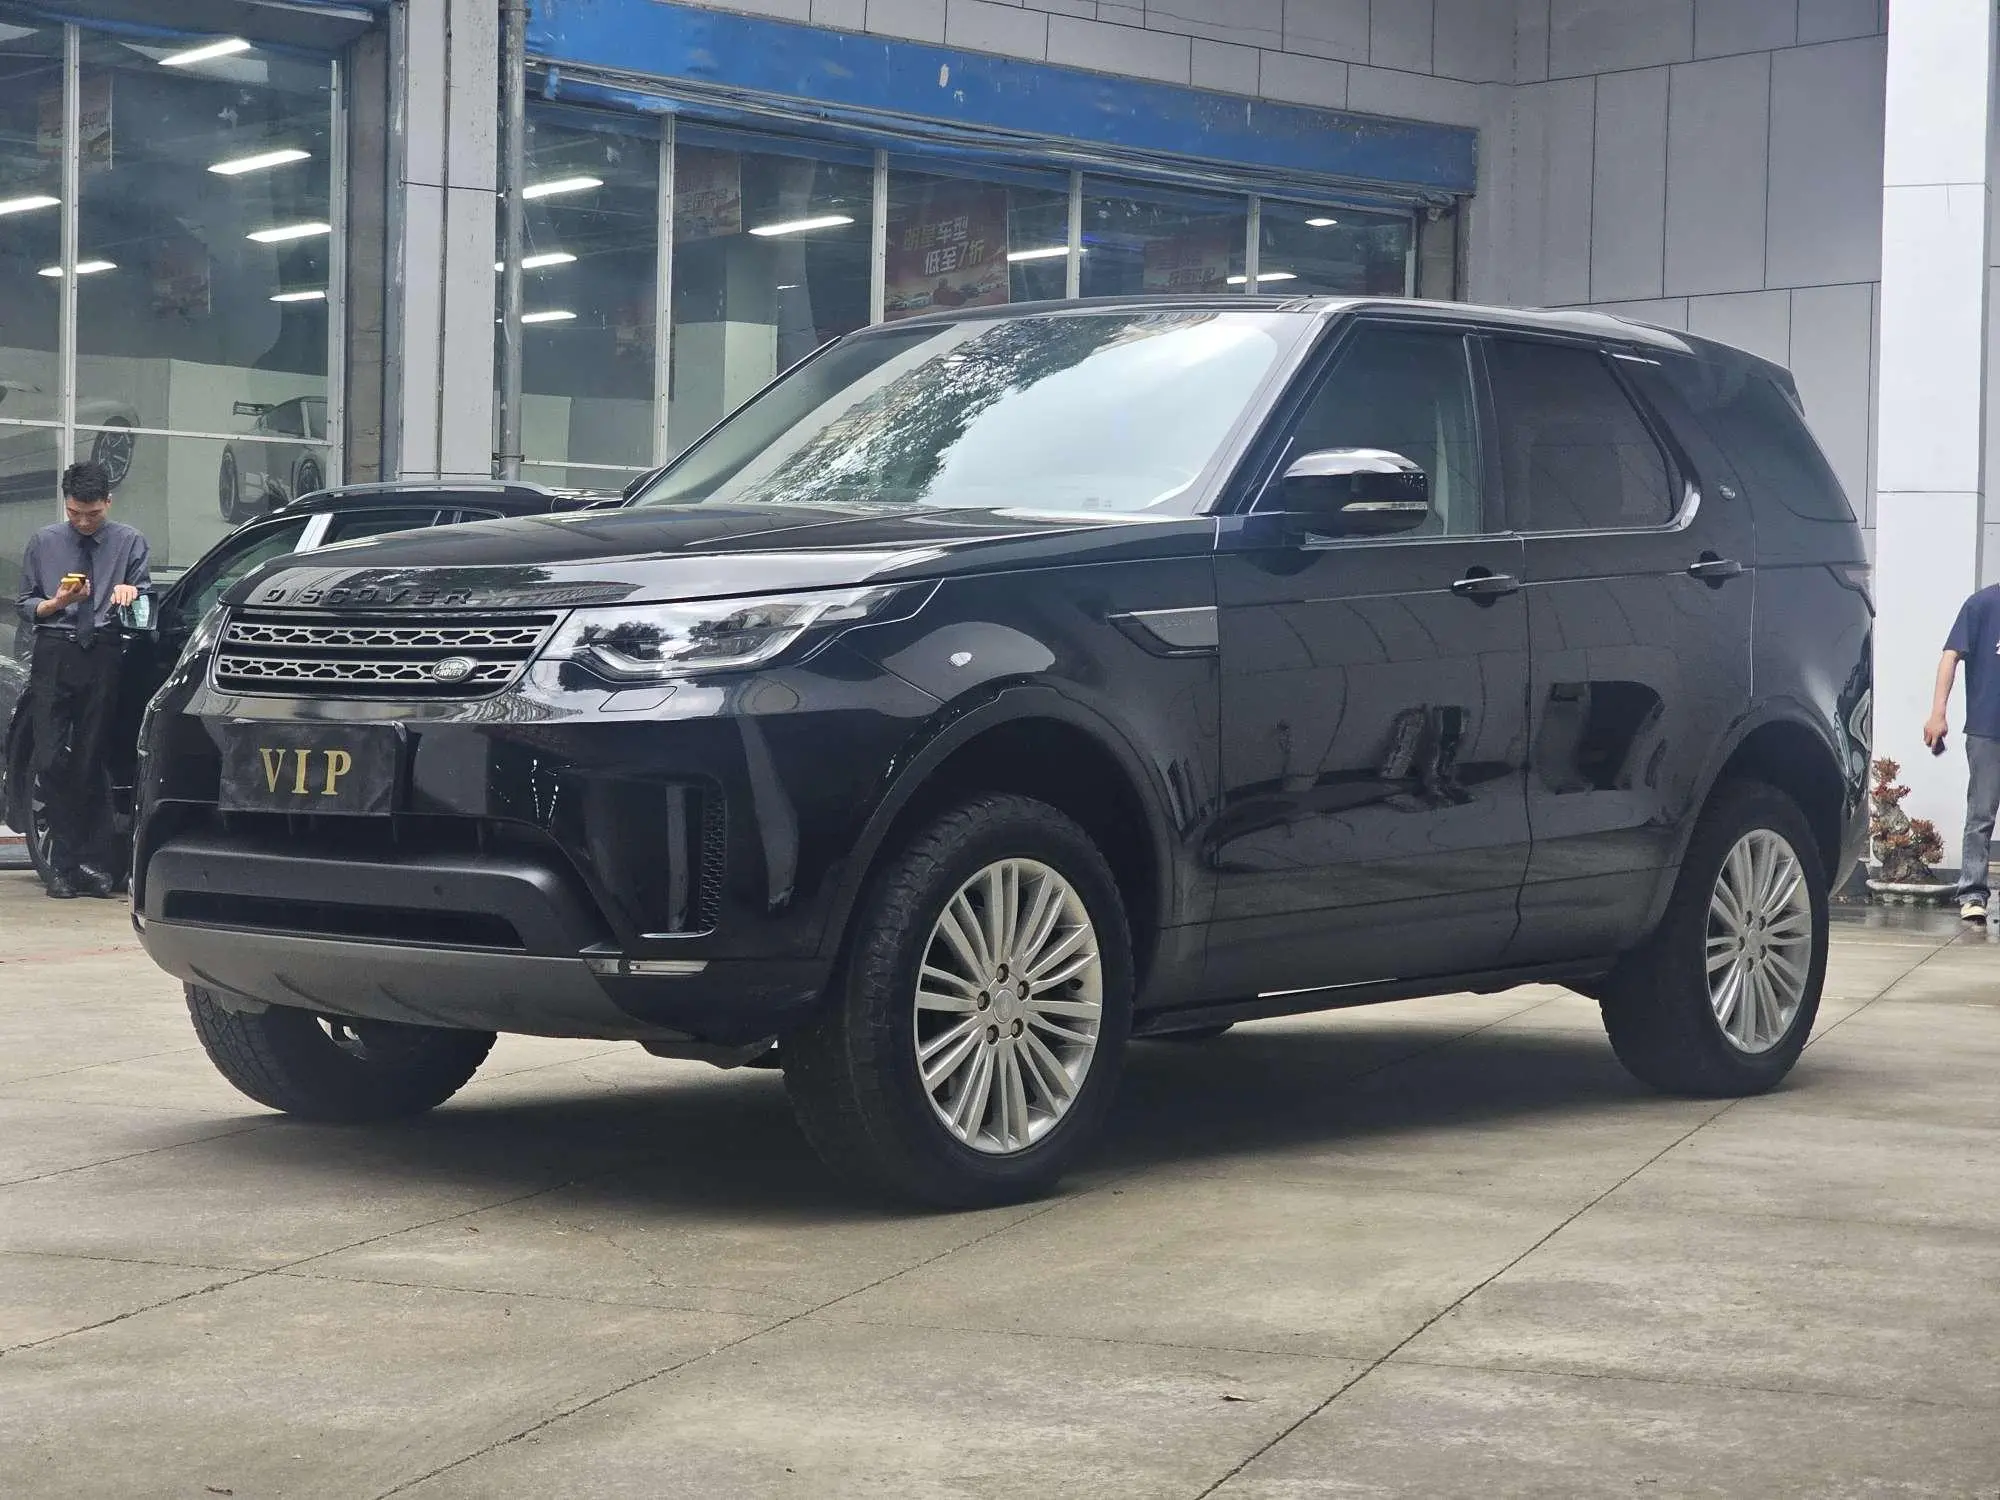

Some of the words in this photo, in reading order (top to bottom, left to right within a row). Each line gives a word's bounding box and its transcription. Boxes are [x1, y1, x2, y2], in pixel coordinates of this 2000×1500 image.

[904, 216, 969, 252] 明星车型
[924, 239, 986, 275] 低至7折
[438, 668, 463, 678] ROVER
[259, 748, 352, 796] VIP
